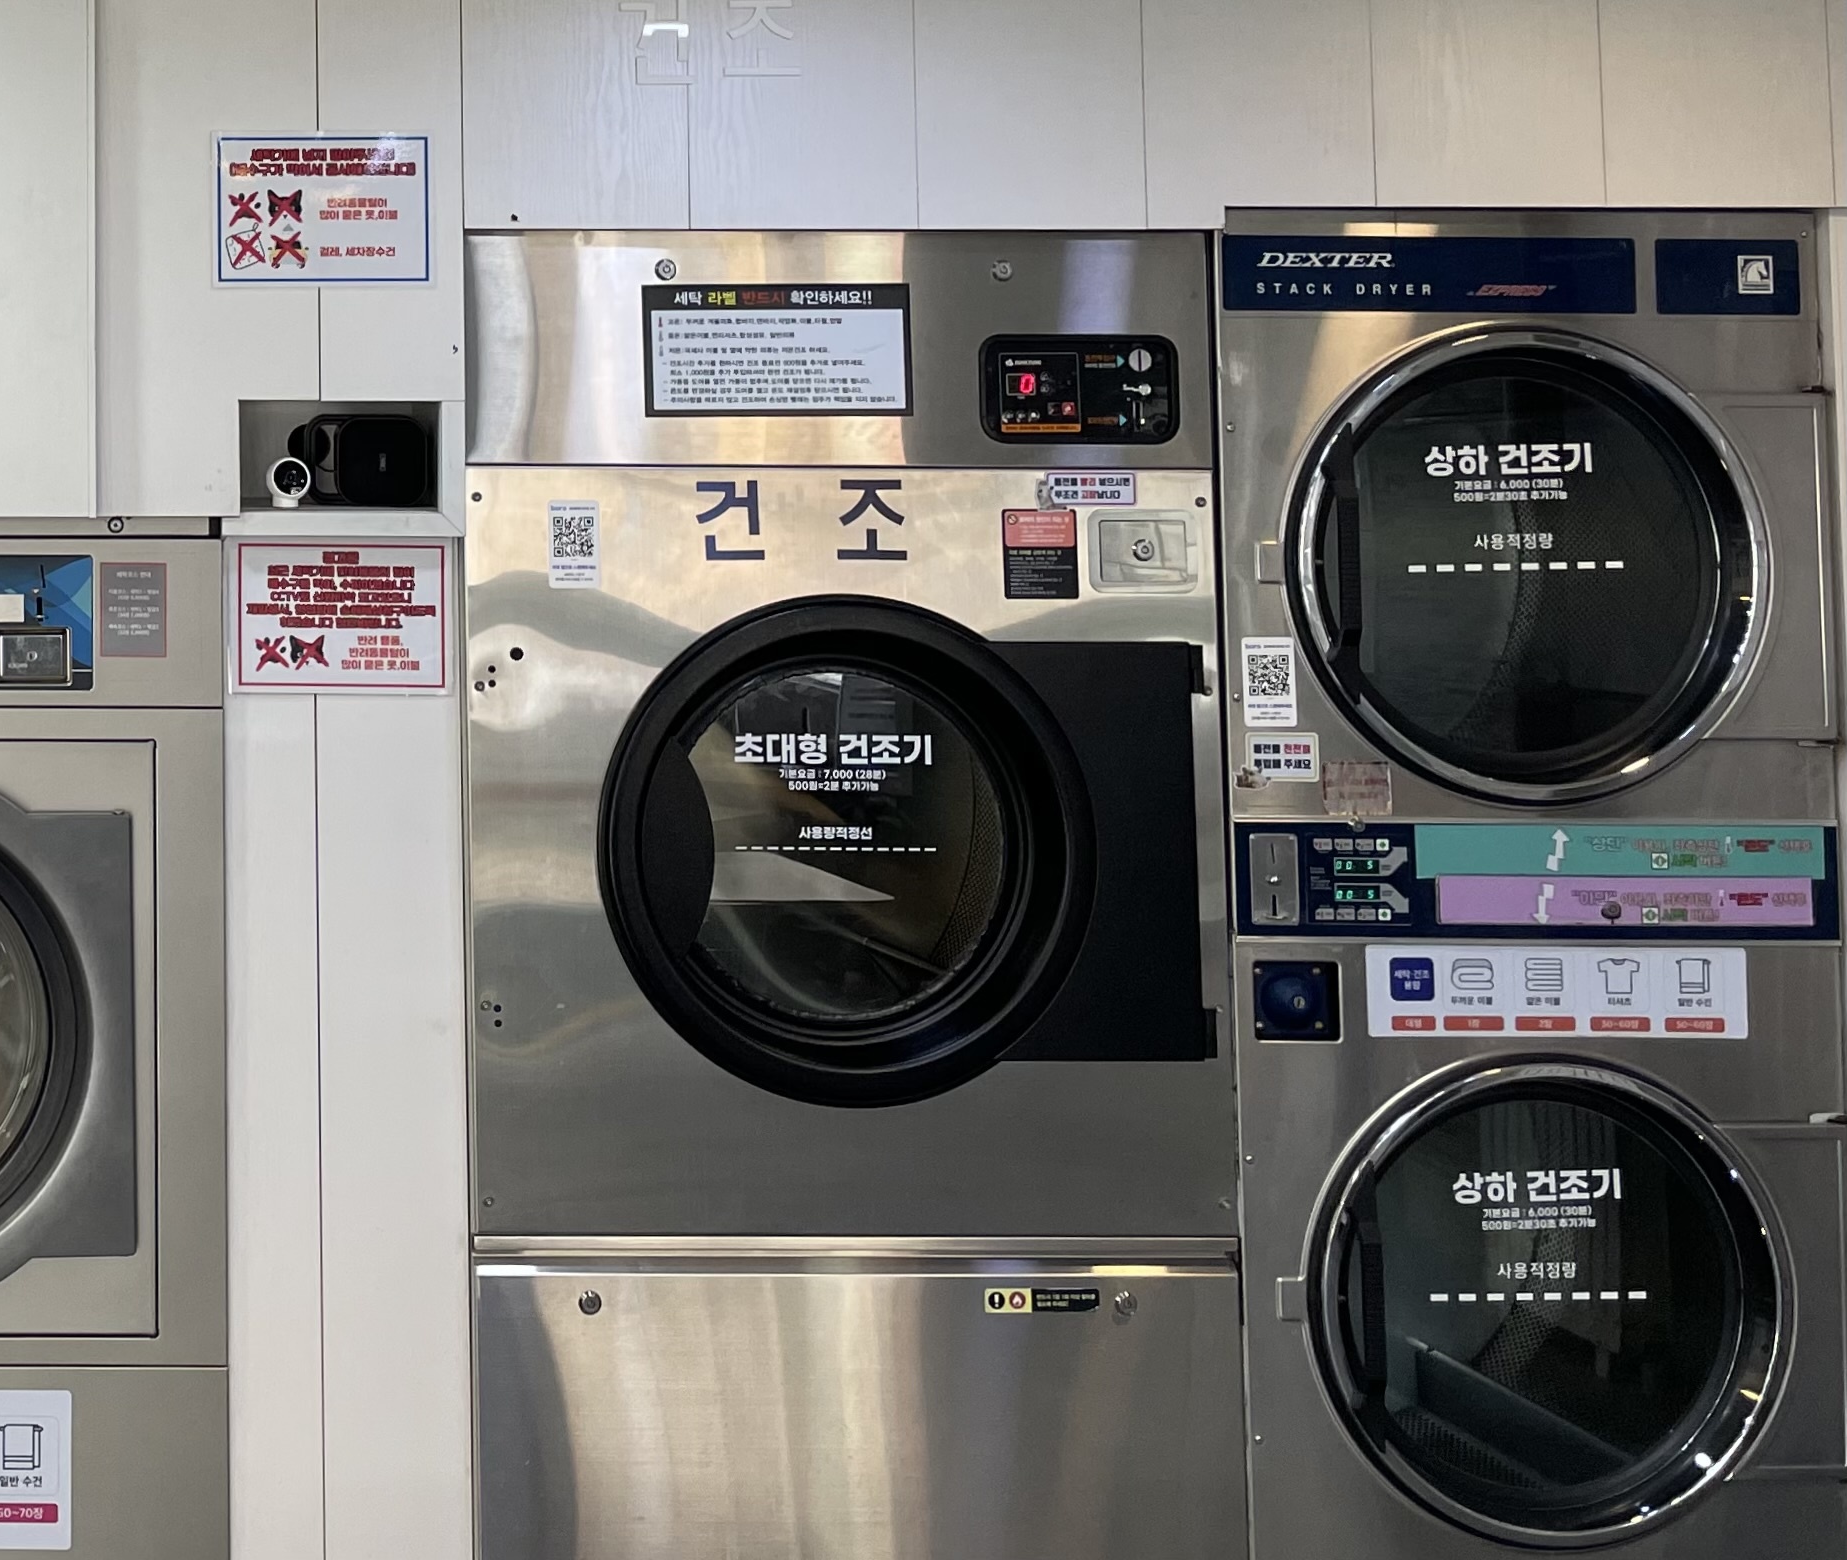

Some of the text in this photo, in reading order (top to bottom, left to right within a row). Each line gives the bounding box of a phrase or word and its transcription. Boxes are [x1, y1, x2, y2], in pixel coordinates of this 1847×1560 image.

[345, 246, 396, 257] 세차장수건
[1257, 251, 1394, 269] DEXTER
[1256, 281, 1433, 297] STACK DRYER
[674, 290, 872, 306] 세탁 라벨 반드시 확인하세요!!
[1019, 373, 1036, 394] 0
[1424, 442, 1593, 477] 상하 건조기
[696, 479, 908, 561] 건조
[1474, 532, 1554, 551] 사용적정량
[734, 732, 933, 766] 초대형 건조기
[779, 768, 816, 780] 기본요금
[855, 769, 887, 780] (28분)
[798, 826, 874, 840] 사용량적정선
[1607, 997, 1632, 1007] 티셔츠
[1453, 1168, 1622, 1204] 상하 건조기
[1482, 1206, 1520, 1218] 기본요금
[1497, 1262, 1577, 1279] 사용적정량
[0, 1475, 43, 1488] 일반 수건
